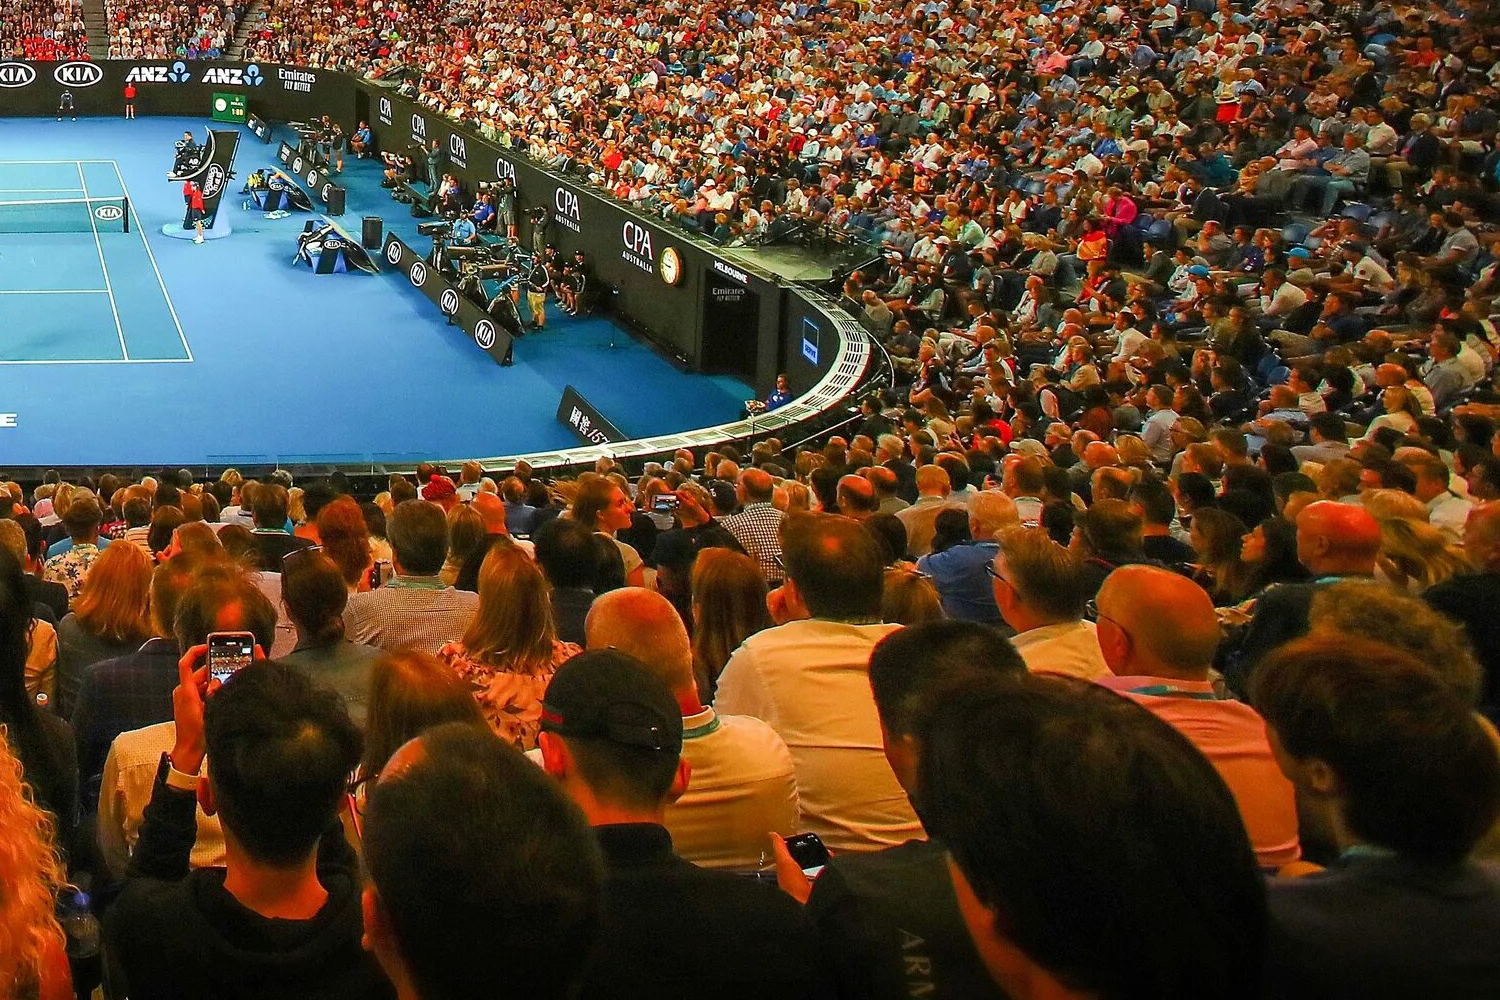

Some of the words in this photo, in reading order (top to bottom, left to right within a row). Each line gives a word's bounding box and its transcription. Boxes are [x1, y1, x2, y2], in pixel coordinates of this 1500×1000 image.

[62, 68, 96, 82] KIA
[125, 66, 169, 83] ANZ
[201, 68, 243, 85] ANZ
[278, 68, 316, 83] Emirates
[379, 97, 393, 118] CPA
[411, 113, 426, 138] CPA
[450, 133, 467, 160] CPA
[555, 188, 581, 221] CPA
[555, 214, 581, 233] AUSTRALIA
[622, 220, 654, 260] CPA
[390, 245, 400, 260] KIA
[622, 250, 653, 274] AUSTRALIA
[411, 267, 424, 284] KIA
[714, 260, 749, 284] MELBOURNE
[712, 287, 745, 296] Emirates
[441, 294, 455, 312] KIA
[477, 325, 493, 348] KIA
